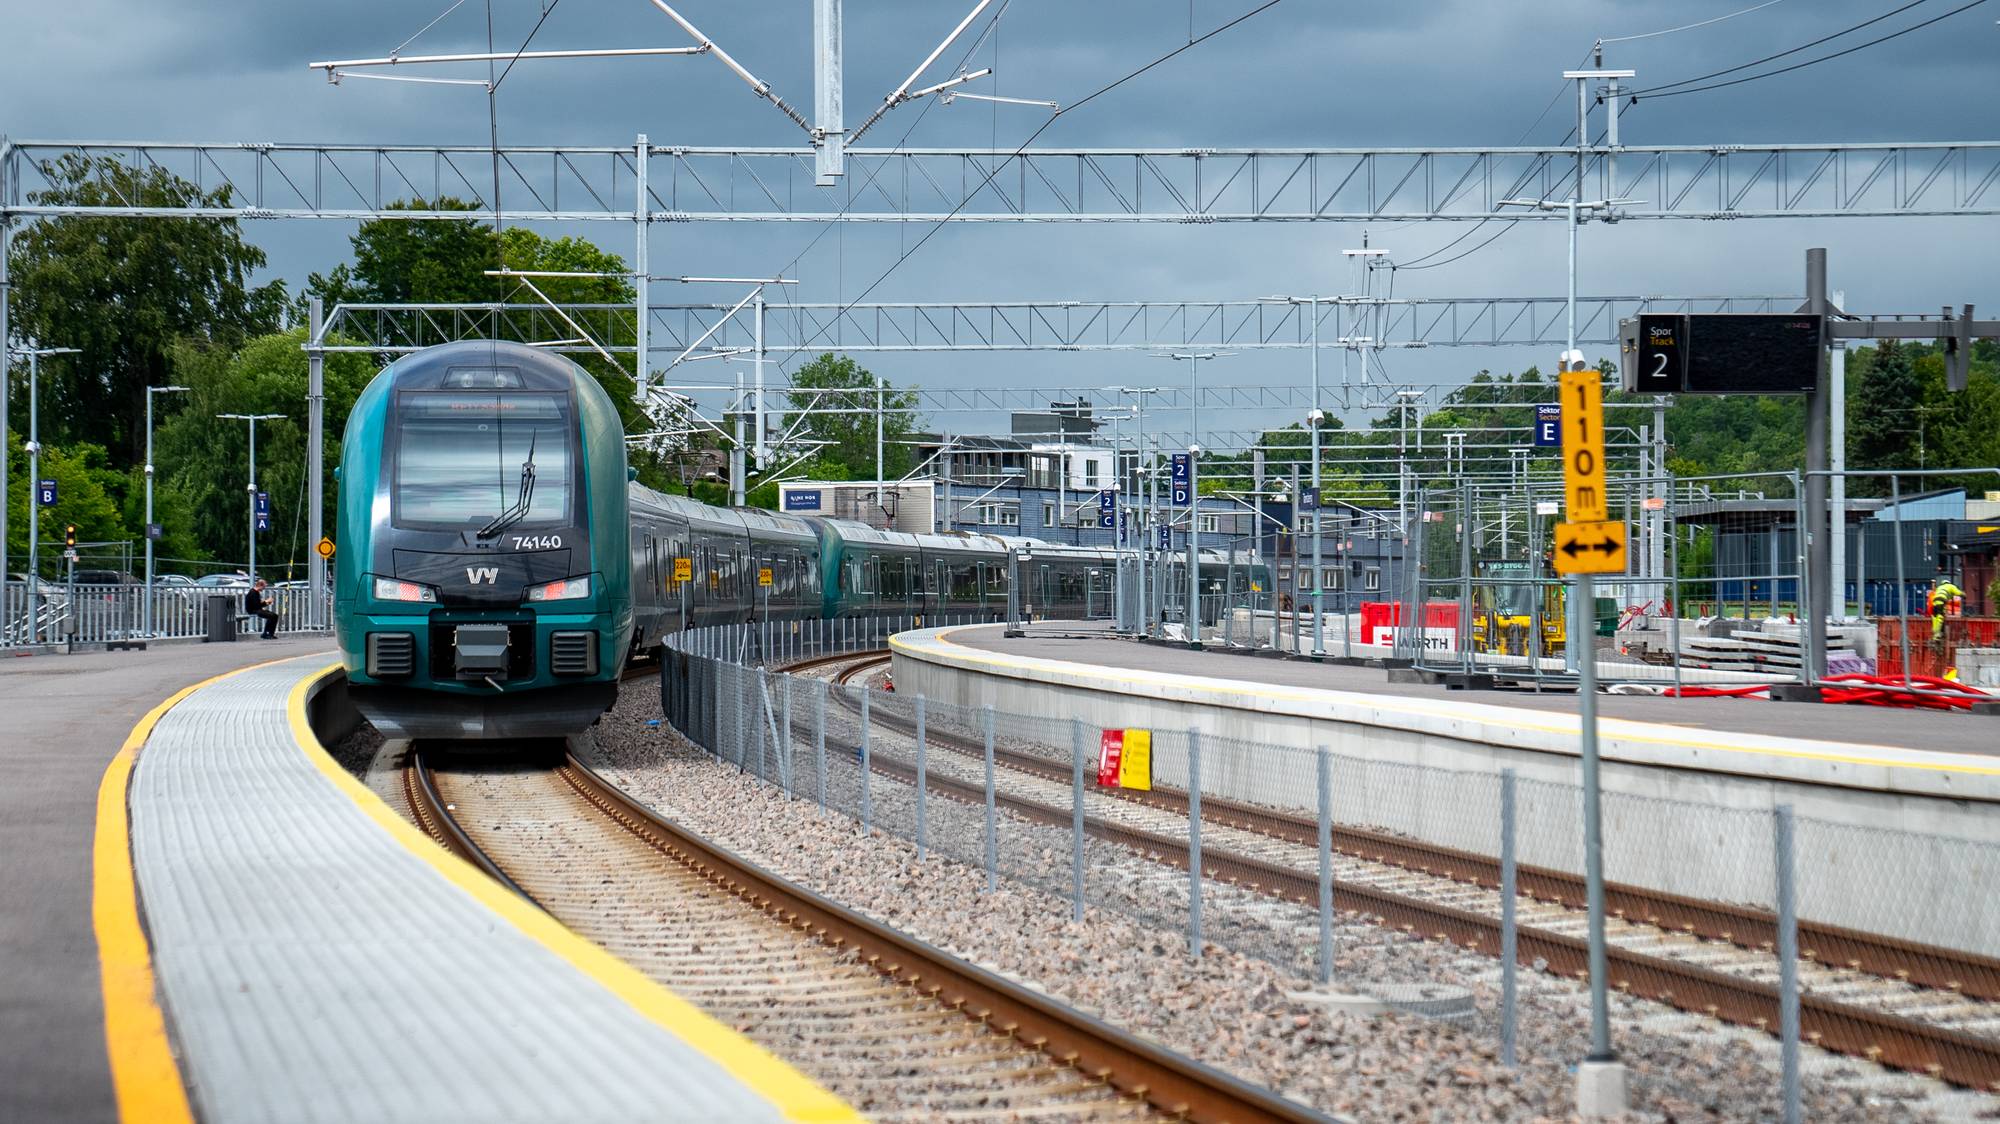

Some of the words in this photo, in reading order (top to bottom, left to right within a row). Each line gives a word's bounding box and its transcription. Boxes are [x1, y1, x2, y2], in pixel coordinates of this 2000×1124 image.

[1650, 326, 1672, 337] Spor
[1650, 337, 1675, 346] Track
[1652, 353, 1667, 377] 2
[1544, 423, 1555, 441] E
[1177, 464, 1185, 476] 2
[44, 490, 52, 502] B
[1105, 498, 1111, 506] 2
[1176, 490, 1186, 502] D
[258, 520, 266, 529] A
[1104, 516, 1111, 525] C
[512, 535, 562, 550] 74140
[466, 567, 499, 584] VY
